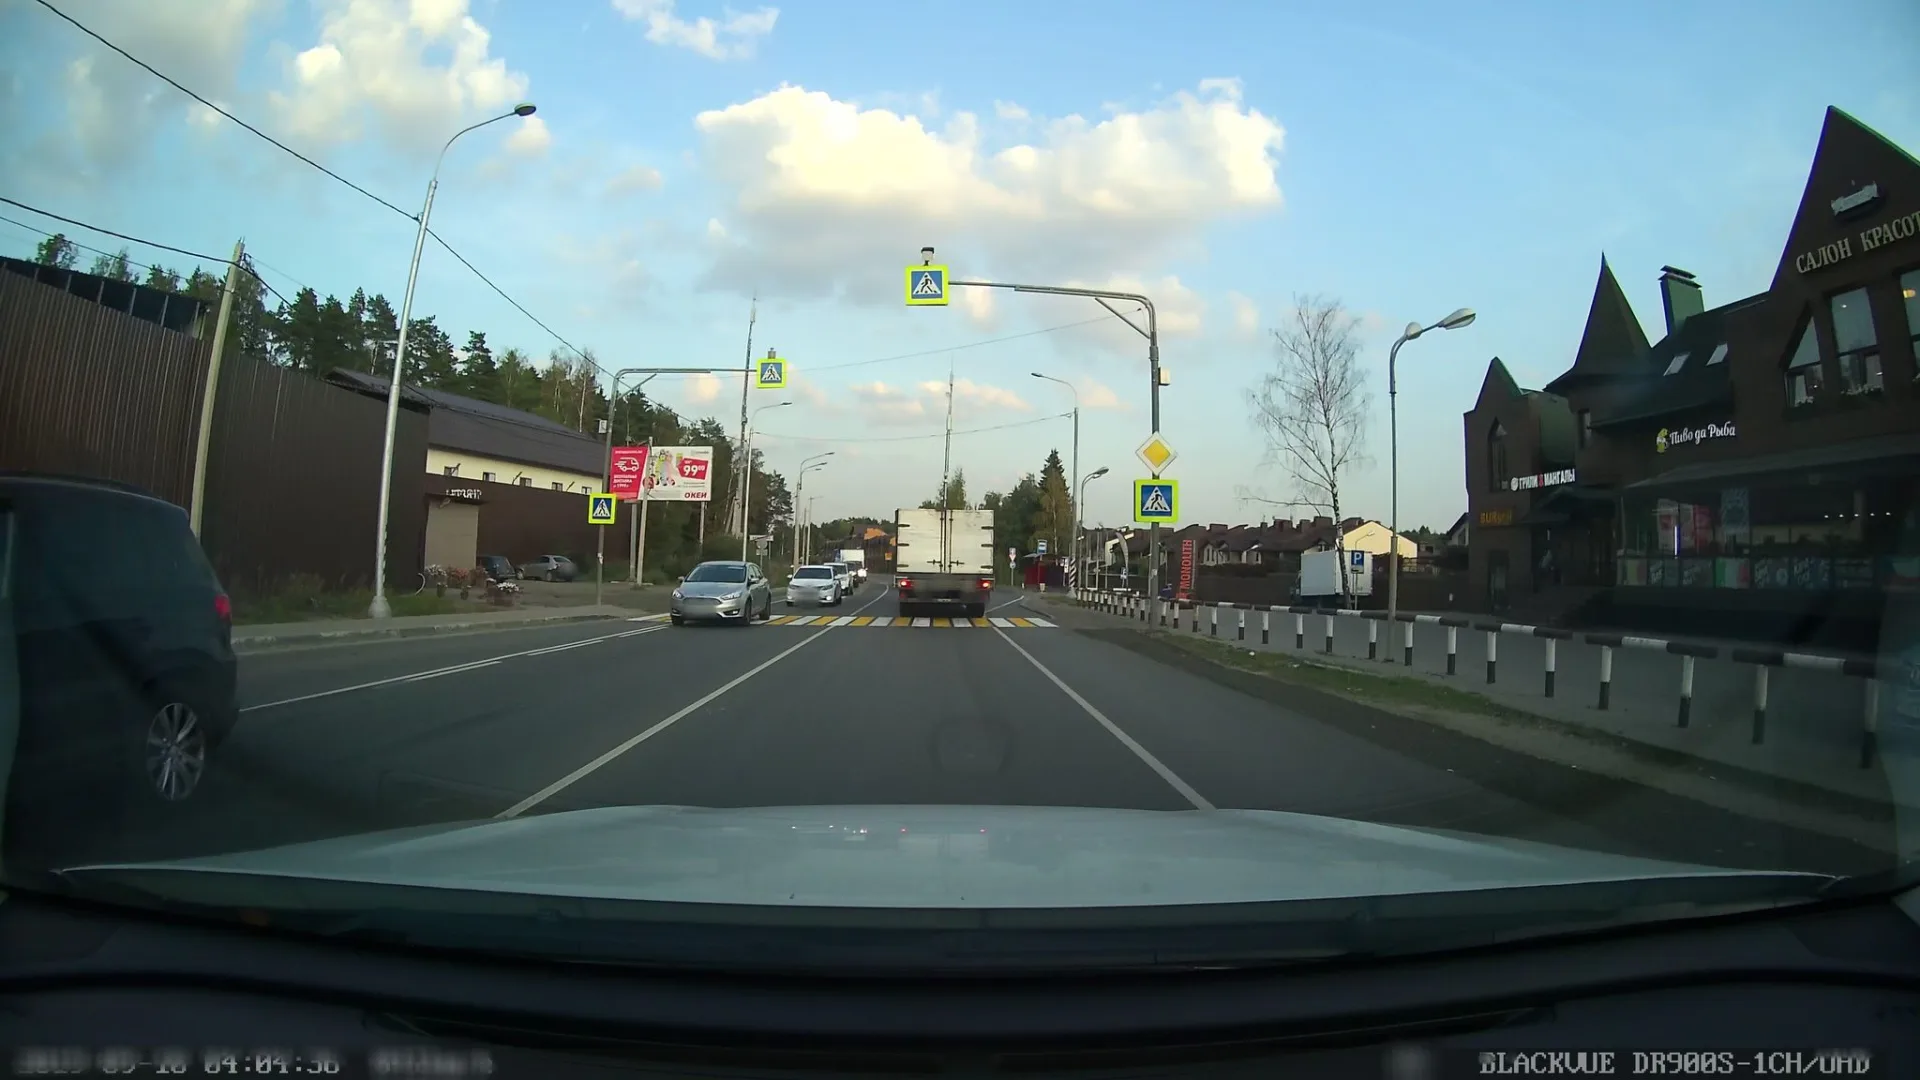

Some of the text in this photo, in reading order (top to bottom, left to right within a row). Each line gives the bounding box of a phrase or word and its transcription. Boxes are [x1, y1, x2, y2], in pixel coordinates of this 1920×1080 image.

[1795, 237, 1852, 274] САЛОН
[1669, 421, 1736, 445] Пиво да Рыба
[1180, 539, 1192, 590] MONOLITH
